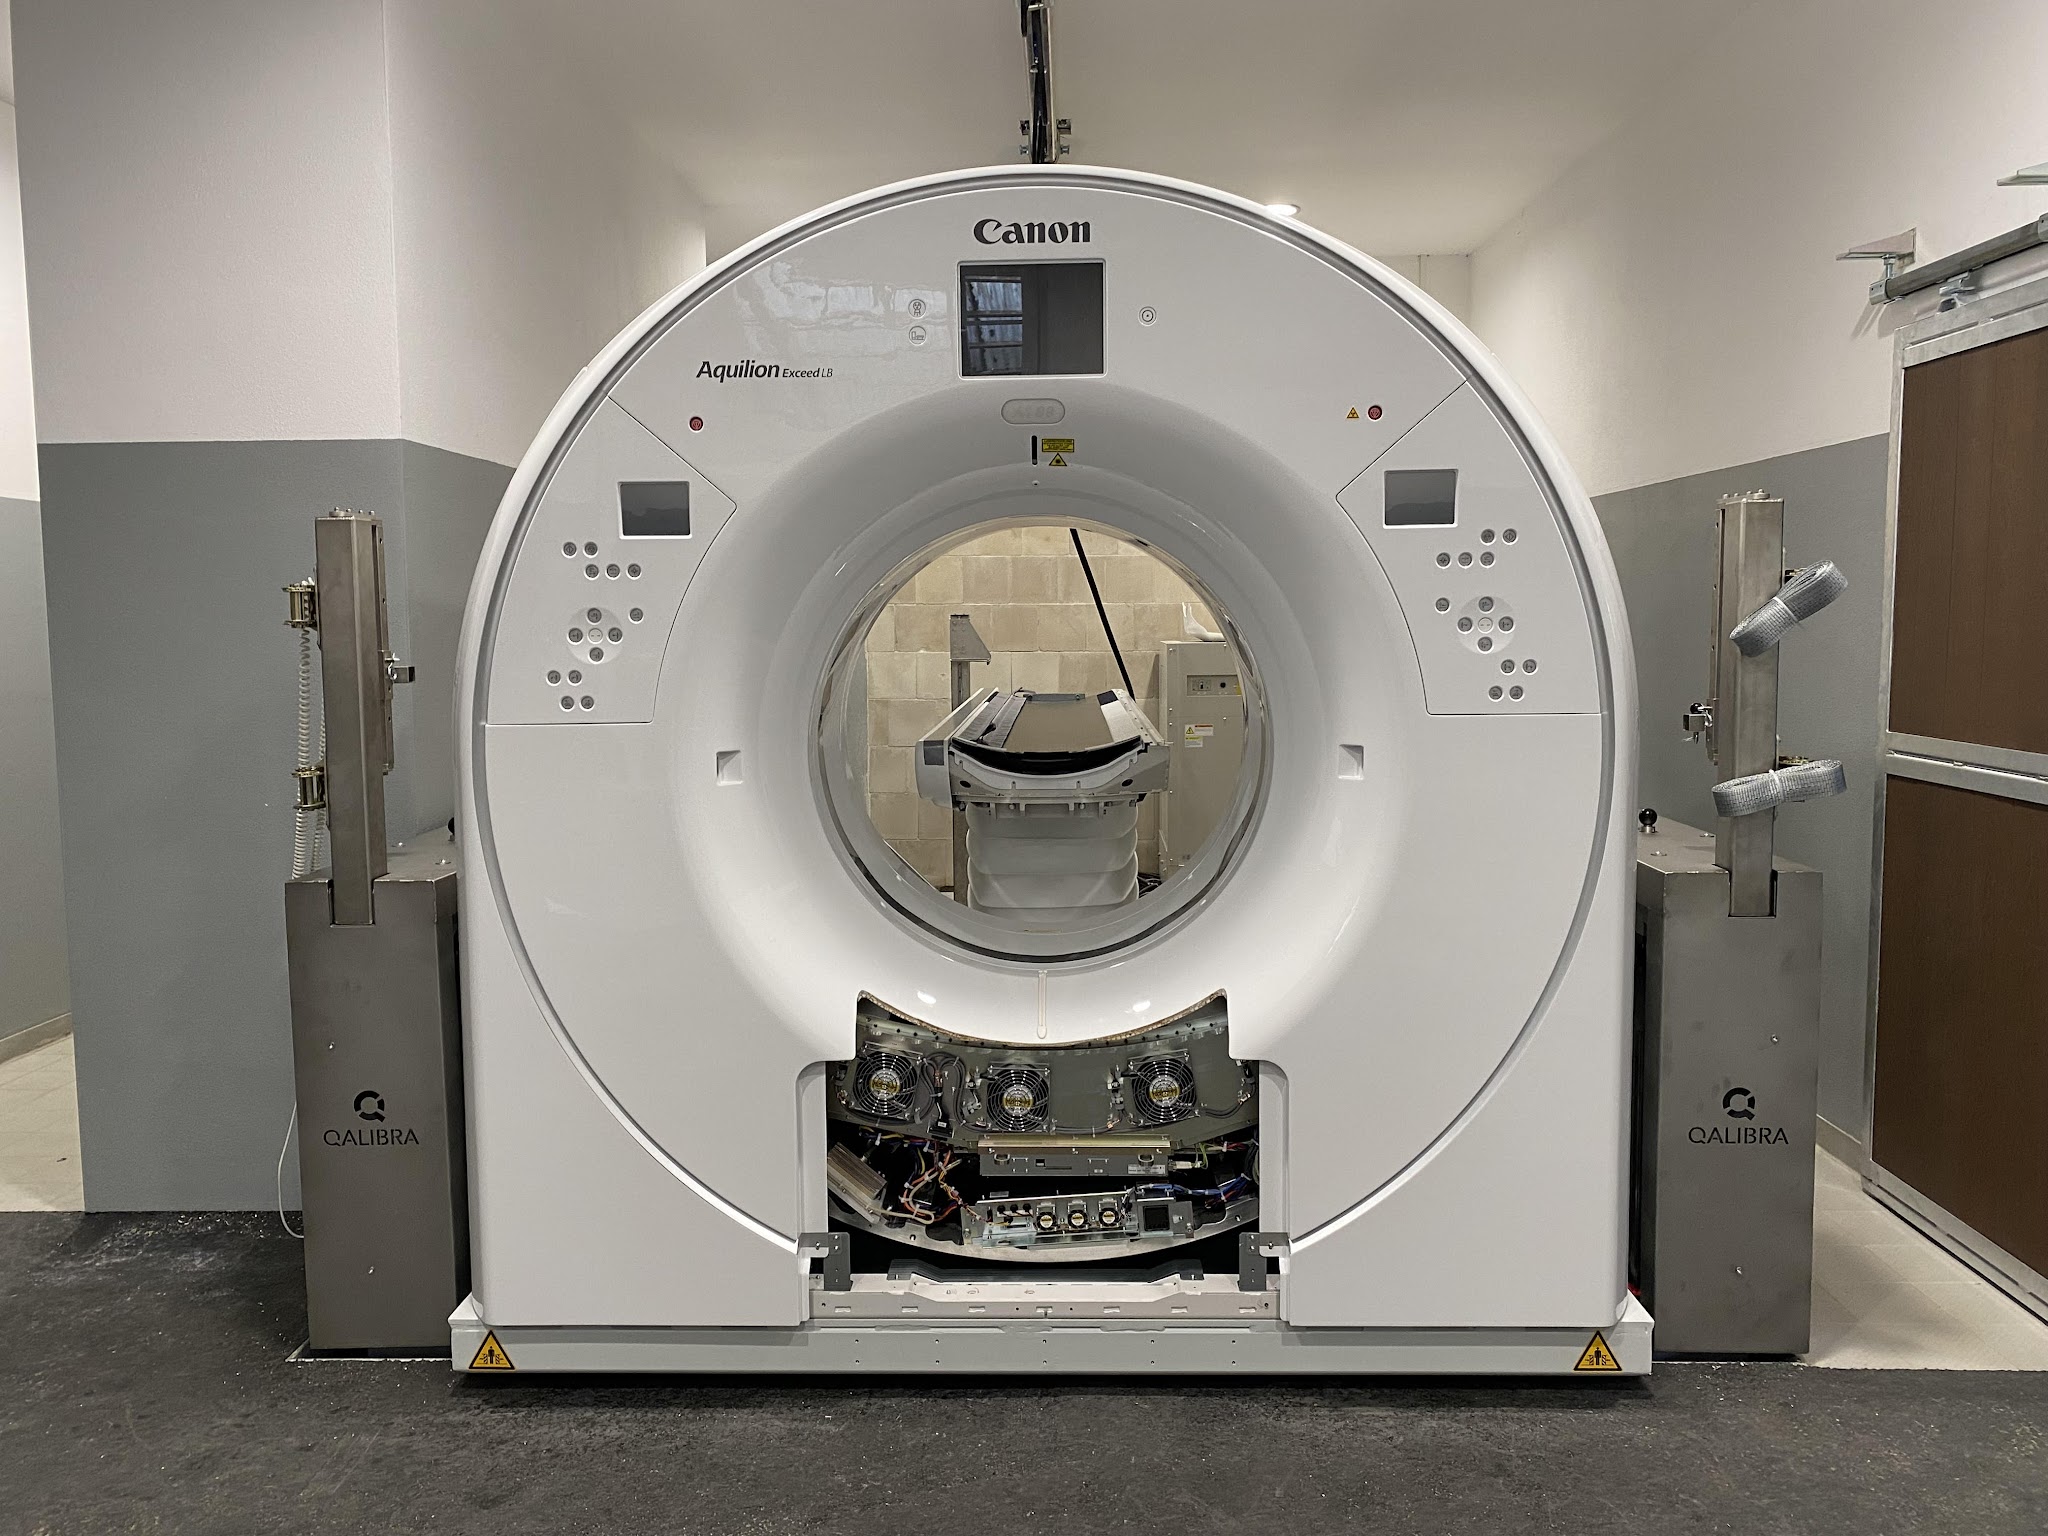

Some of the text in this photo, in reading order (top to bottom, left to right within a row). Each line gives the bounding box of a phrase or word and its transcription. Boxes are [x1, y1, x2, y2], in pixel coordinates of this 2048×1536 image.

[973, 218, 1091, 245] Canon
[696, 360, 834, 383] Aquilion Exceed LB
[323, 1128, 420, 1147] QALIBRA
[1688, 1126, 1789, 1145] QALIBRA
